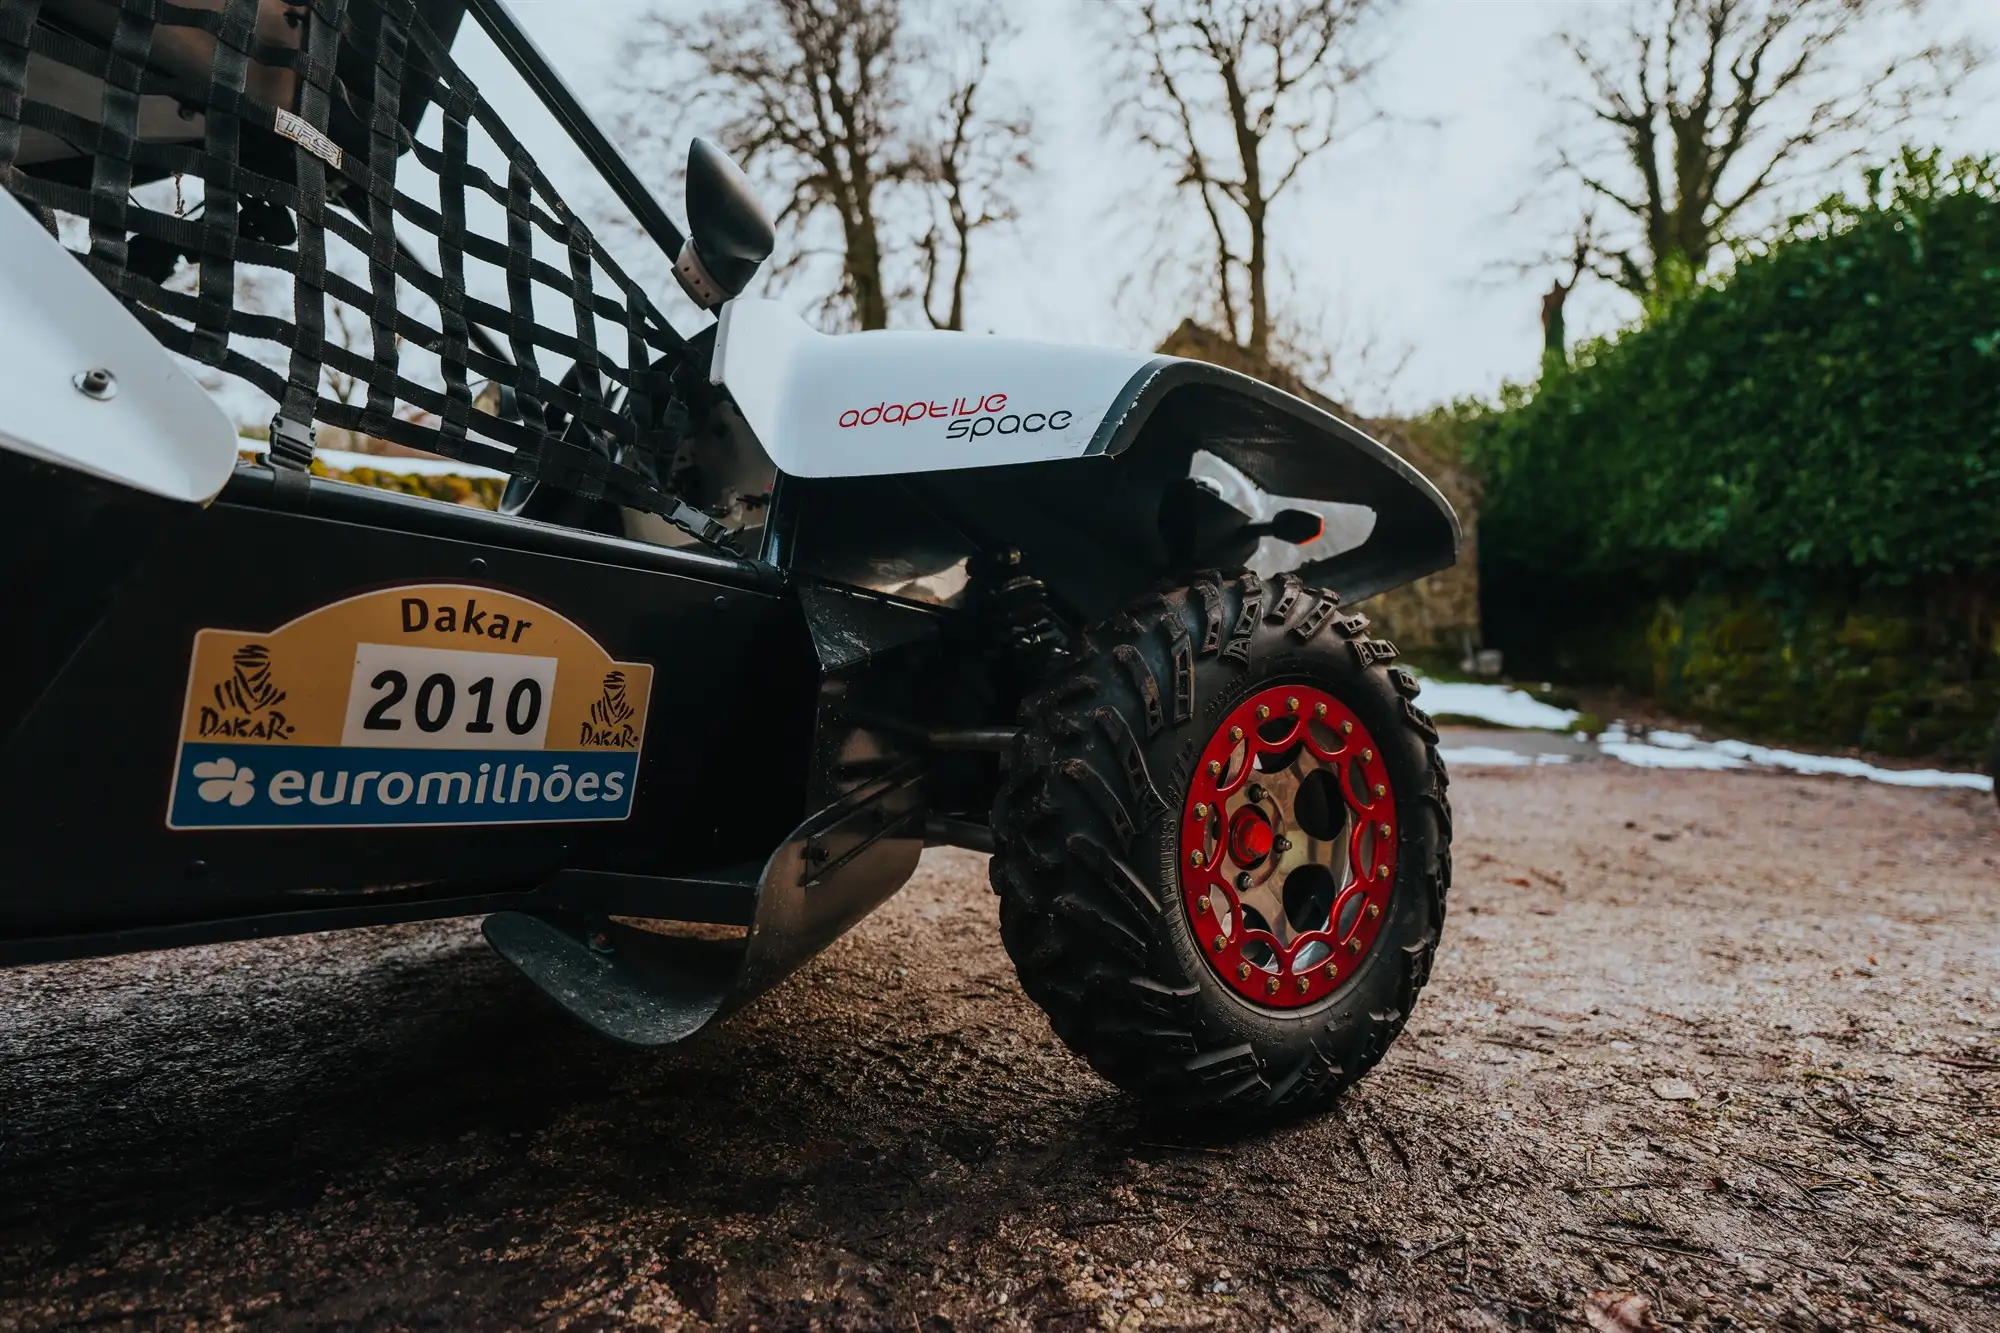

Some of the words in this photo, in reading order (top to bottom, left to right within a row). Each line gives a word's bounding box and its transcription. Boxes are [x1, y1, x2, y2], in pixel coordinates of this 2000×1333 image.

[838, 393, 1008, 427] adaptive
[945, 410, 1073, 443] space
[400, 598, 533, 644] Dakar
[362, 668, 543, 736] 2010
[1156, 818, 1180, 903] CROSS
